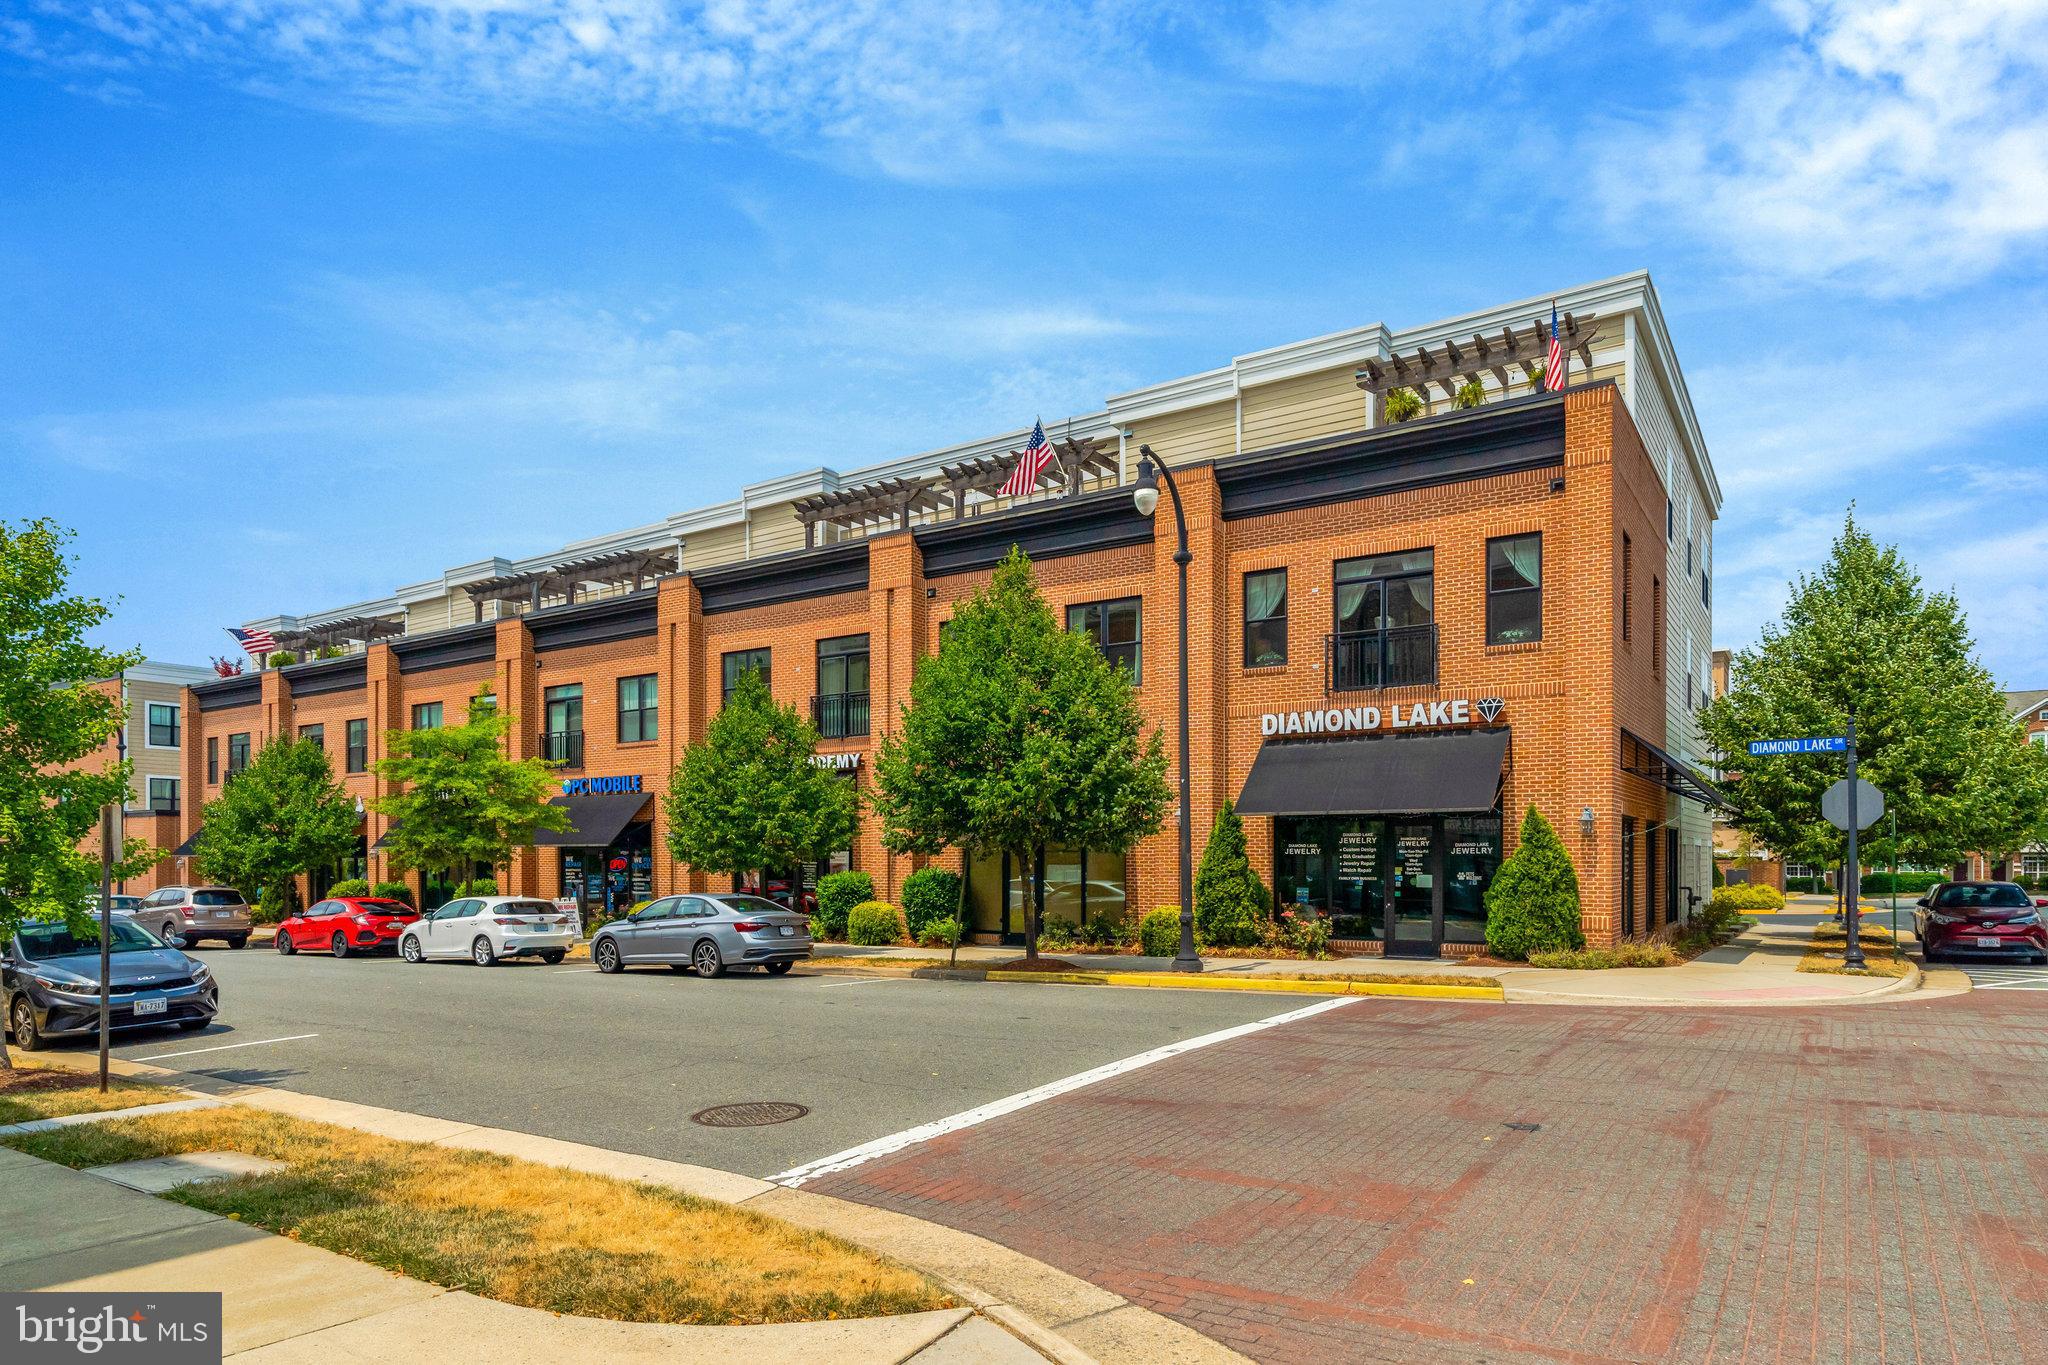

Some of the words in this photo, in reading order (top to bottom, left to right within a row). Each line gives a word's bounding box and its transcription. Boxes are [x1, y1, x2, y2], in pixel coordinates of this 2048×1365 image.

[1262, 707, 1381, 735] DIAMOND
[1392, 700, 1470, 728] LAKE
[1752, 740, 1800, 754] DIAMOND
[1804, 738, 1833, 751] LAKE
[570, 778, 589, 794] PC
[591, 775, 641, 793] MOBILE
[1450, 847, 1494, 855] JEWELRY
[609, 858, 628, 870] OPEN
